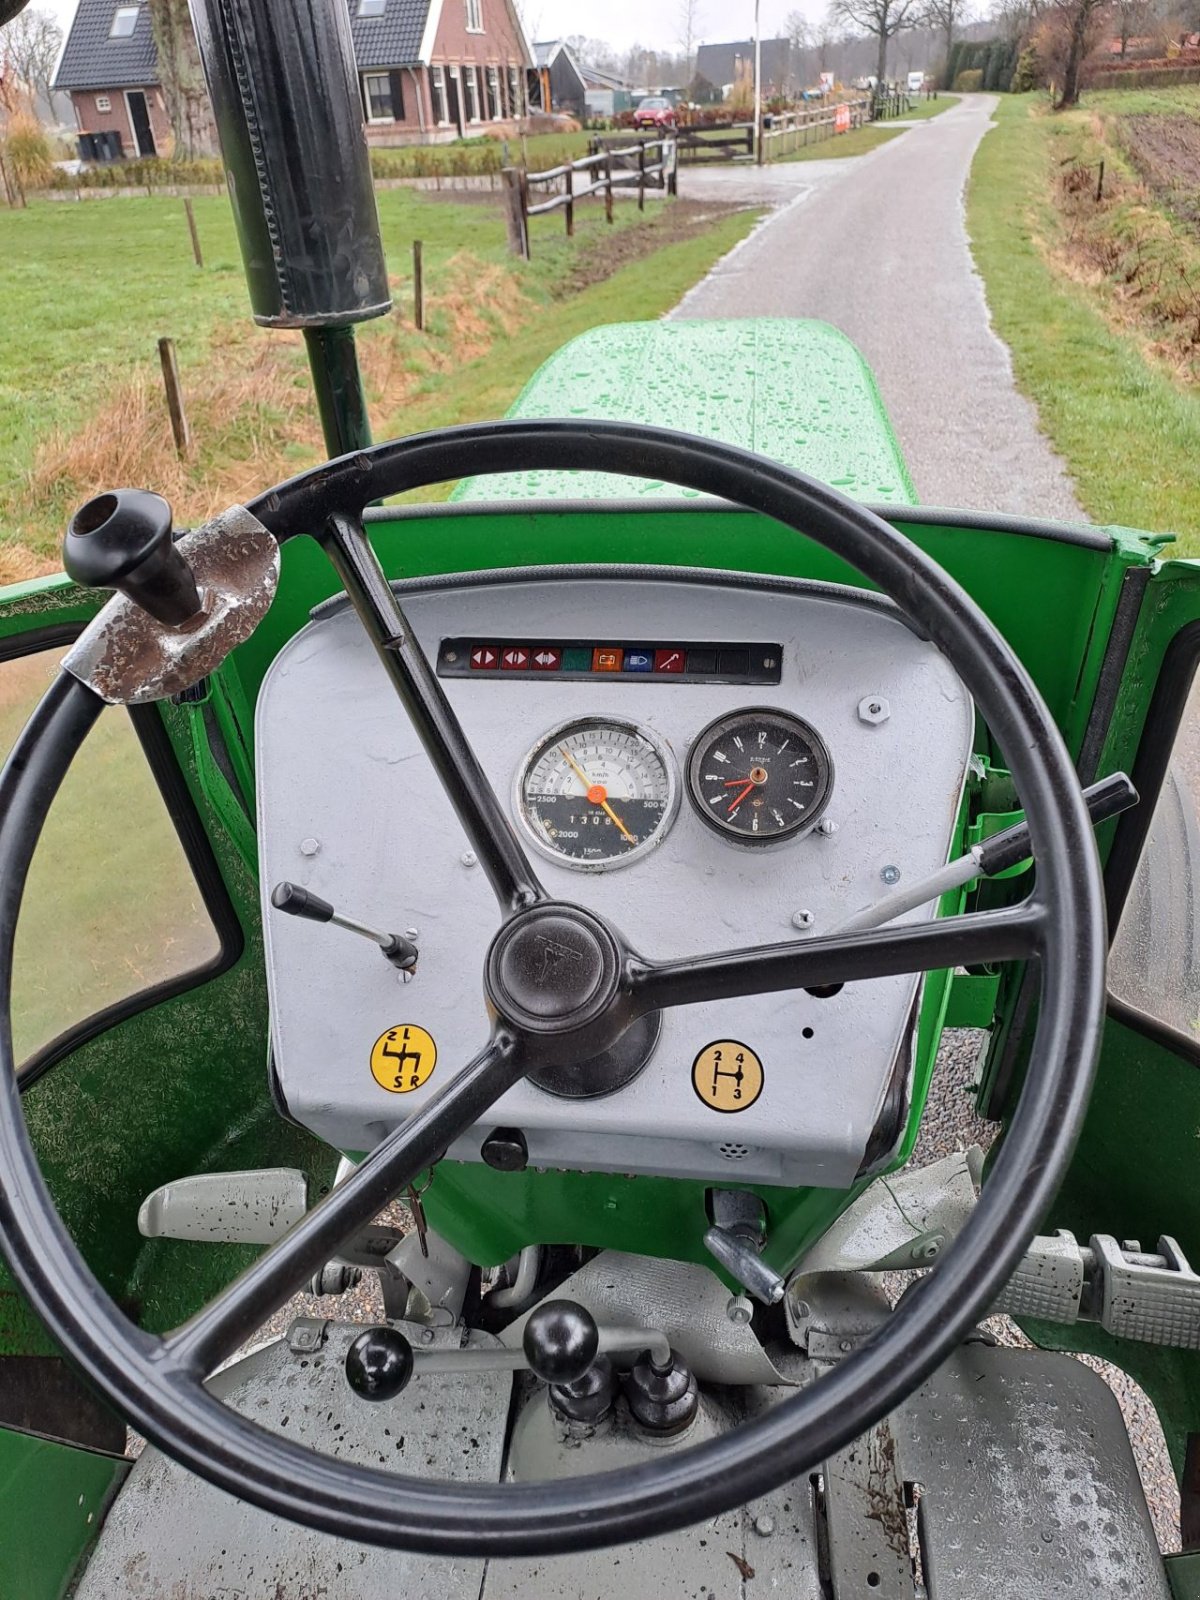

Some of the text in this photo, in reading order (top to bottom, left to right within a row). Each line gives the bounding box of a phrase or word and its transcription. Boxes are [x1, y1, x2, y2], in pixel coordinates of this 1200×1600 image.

[733, 736, 743, 748] 11
[758, 732, 767, 744] 12
[795, 757, 808, 765] 2
[643, 801, 659, 809] 500
[752, 818, 759, 831] 6
[558, 831, 578, 839] 2000
[620, 833, 639, 841] 100
[714, 1050, 744, 1063] 2 4
[393, 1075, 419, 1088] S R
[712, 1086, 742, 1099] 1 3
